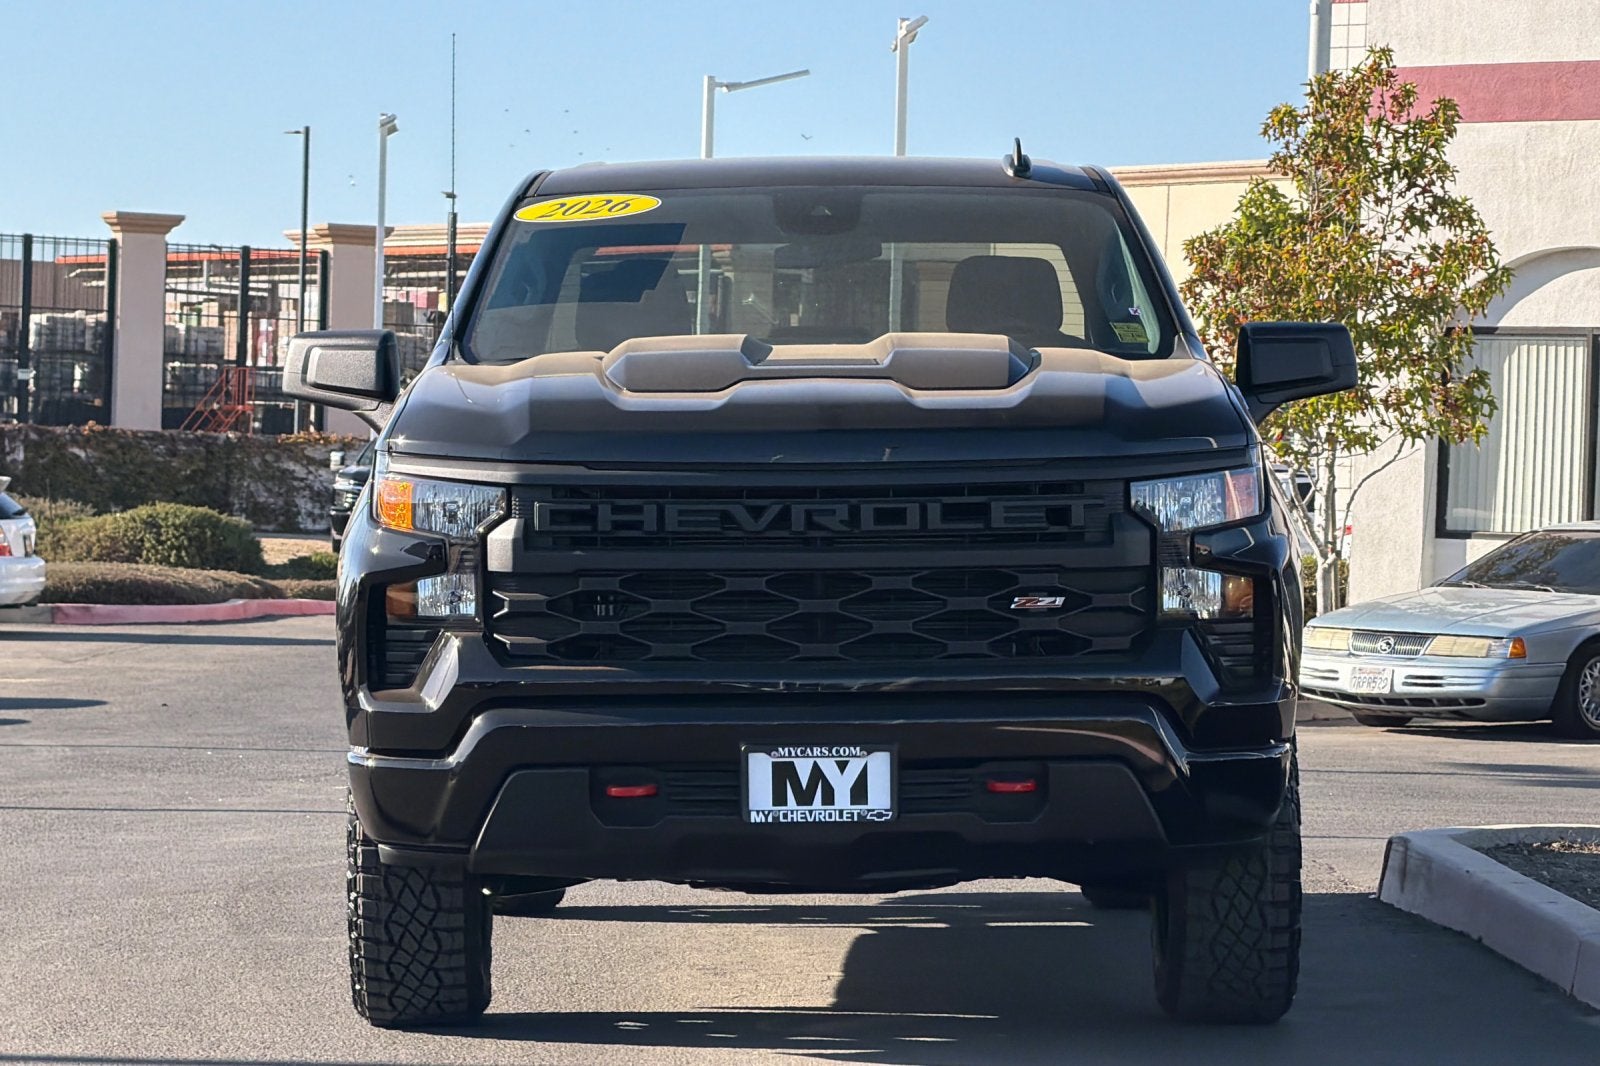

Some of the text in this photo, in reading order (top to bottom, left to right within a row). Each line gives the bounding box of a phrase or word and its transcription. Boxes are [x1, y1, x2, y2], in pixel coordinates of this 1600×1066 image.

[535, 198, 640, 219] 2026
[534, 500, 1103, 533] CHEVROLET
[1011, 597, 1065, 608] Z71
[778, 747, 860, 757] MYCARS.COM
[771, 760, 868, 806] MY
[779, 811, 859, 822] CHEVROLET
